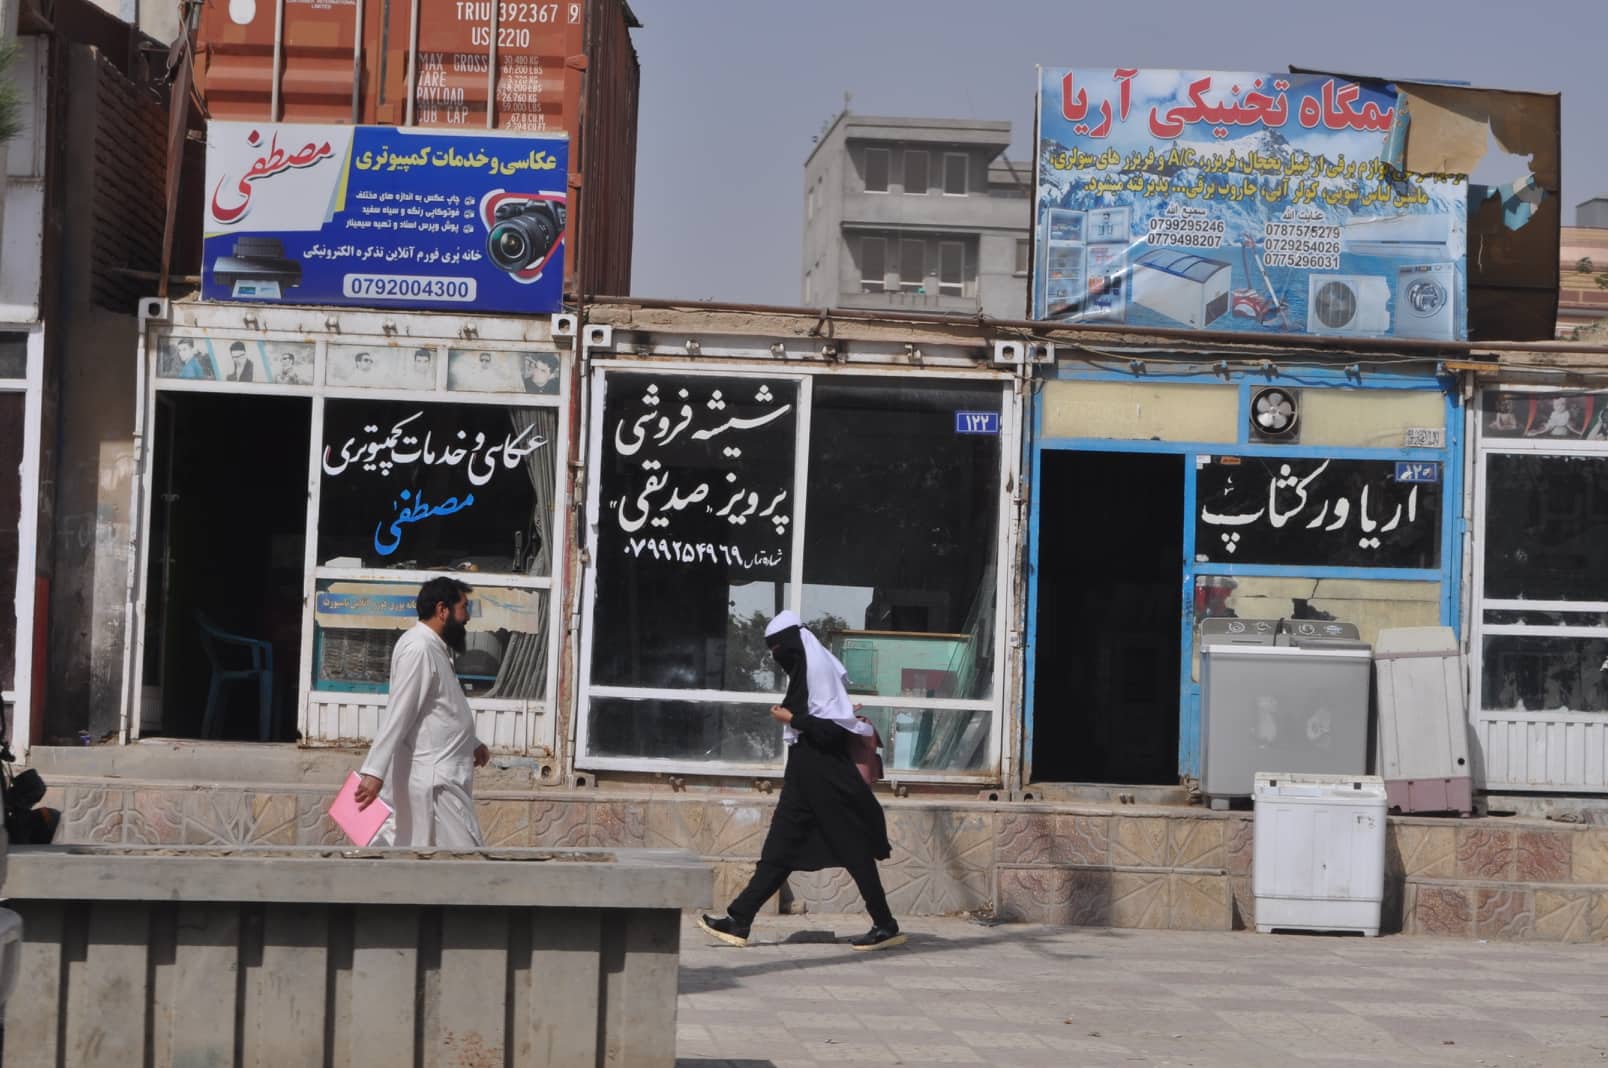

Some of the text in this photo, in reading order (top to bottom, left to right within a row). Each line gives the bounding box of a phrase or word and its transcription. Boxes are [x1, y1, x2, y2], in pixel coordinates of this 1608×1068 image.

[456, 2, 579, 23] TRIU 392367 9
[472, 27, 530, 48] US 2210
[418, 53, 488, 73] MAX GROSS
[418, 71, 447, 87] TARE
[417, 88, 464, 105] PAYLOAD
[1061, 67, 1139, 139] آریا
[447, 106, 469, 124] CAP
[1149, 76, 1289, 138] تخنیکی
[355, 145, 557, 175] عکاسی و خدمات کمپیوتری
[1096, 146, 1121, 171] های
[1122, 147, 1155, 172] فریزر
[1158, 155, 1165, 171] و
[1167, 148, 1196, 167] A/C
[1284, 152, 1310, 176] قبیل
[1311, 154, 1324, 177] از
[1325, 154, 1357, 179] برقی
[210, 128, 332, 222] مصطفی
[355, 190, 460, 206] چاپ عکس به اندازه های مختلف
[1217, 178, 1258, 201] جاروب
[1291, 180, 1319, 205] کولر
[1361, 183, 1392, 206] لباس
[362, 205, 381, 215] سفید
[382, 206, 399, 215] سیاه
[425, 206, 460, 218] فوتوکاپی
[1166, 205, 1207, 219] سمیع الله
[1282, 207, 1295, 221] الله
[1150, 218, 1225, 233] 0799295246
[1265, 223, 1341, 239] 0787575279
[1147, 233, 1222, 248] 0779498207
[1264, 238, 1340, 253] 0729254026
[303, 243, 355, 260] الکترونیکی
[356, 246, 385, 261] تذکره
[385, 246, 416, 262] آنلاین
[416, 247, 440, 263] فورم
[461, 248, 483, 262] خانه
[1264, 253, 1339, 269] 0775296031
[351, 278, 469, 298] 0792004300
[615, 384, 791, 458] شیشه فروشی
[322, 410, 548, 486] عکاسی و خدمات کمپیوتری
[716, 472, 790, 535] پرویز
